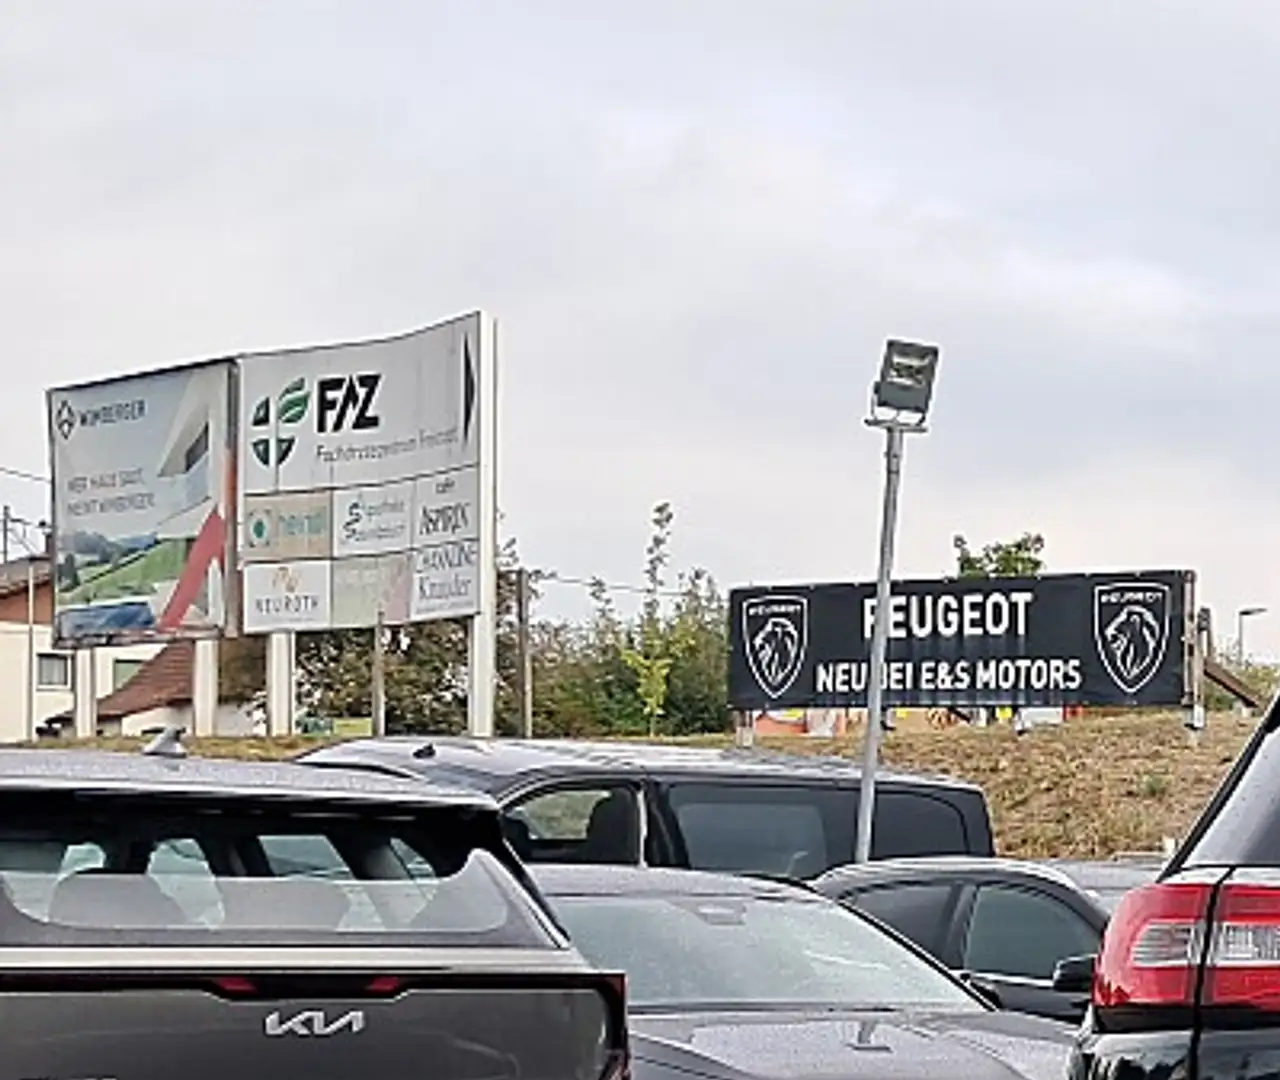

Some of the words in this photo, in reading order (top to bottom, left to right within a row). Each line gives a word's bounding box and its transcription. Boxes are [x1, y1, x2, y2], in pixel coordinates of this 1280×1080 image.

[317, 373, 381, 433] FAZ
[863, 591, 1033, 639] PEUGEOT
[816, 662, 868, 693] NEU
[880, 661, 912, 691] EI
[920, 660, 971, 691] E&S
[975, 659, 1082, 690] MOTORS
